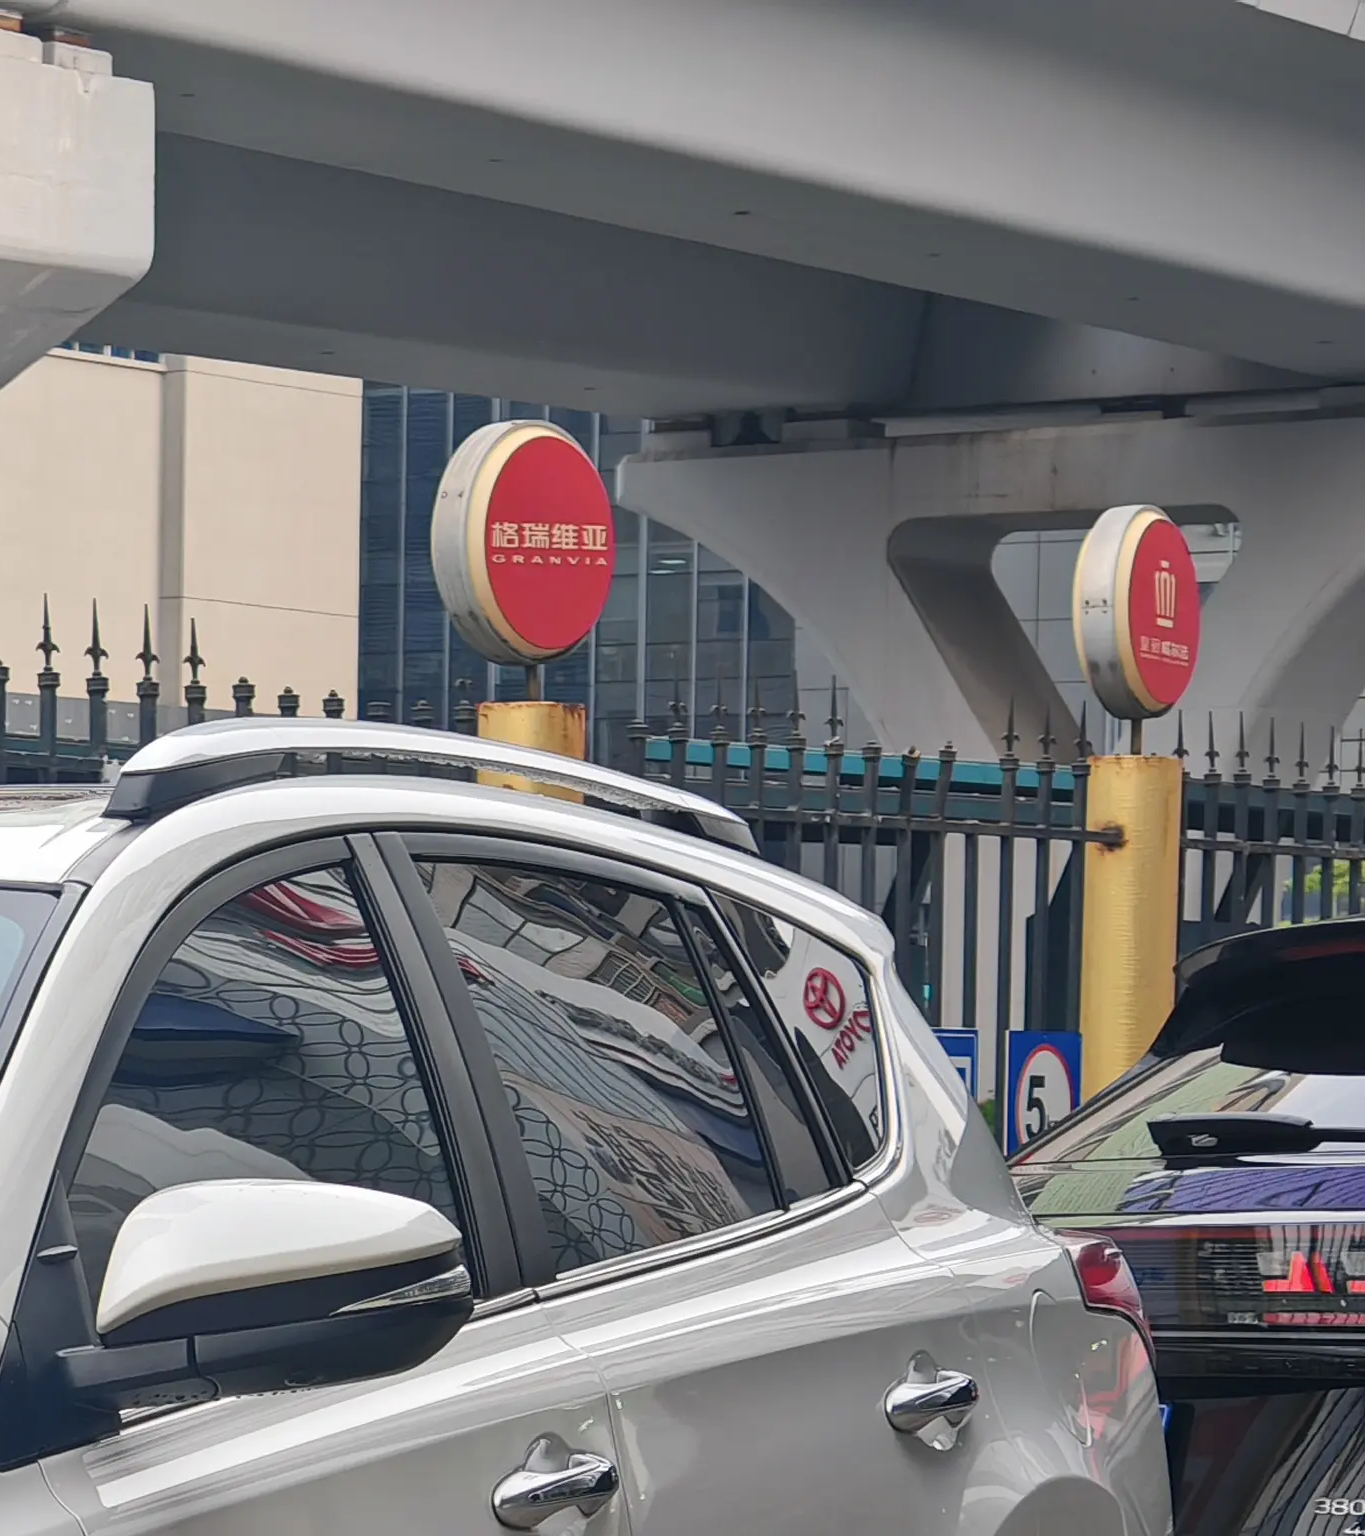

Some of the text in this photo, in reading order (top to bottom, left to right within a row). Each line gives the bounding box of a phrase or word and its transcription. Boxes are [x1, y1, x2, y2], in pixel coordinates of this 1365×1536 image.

[490, 522, 609, 551] 格瑞维亚
[491, 554, 609, 566] GRANVIA
[1025, 1074, 1046, 1139] 5
[1314, 1498, 1365, 1516] 380
